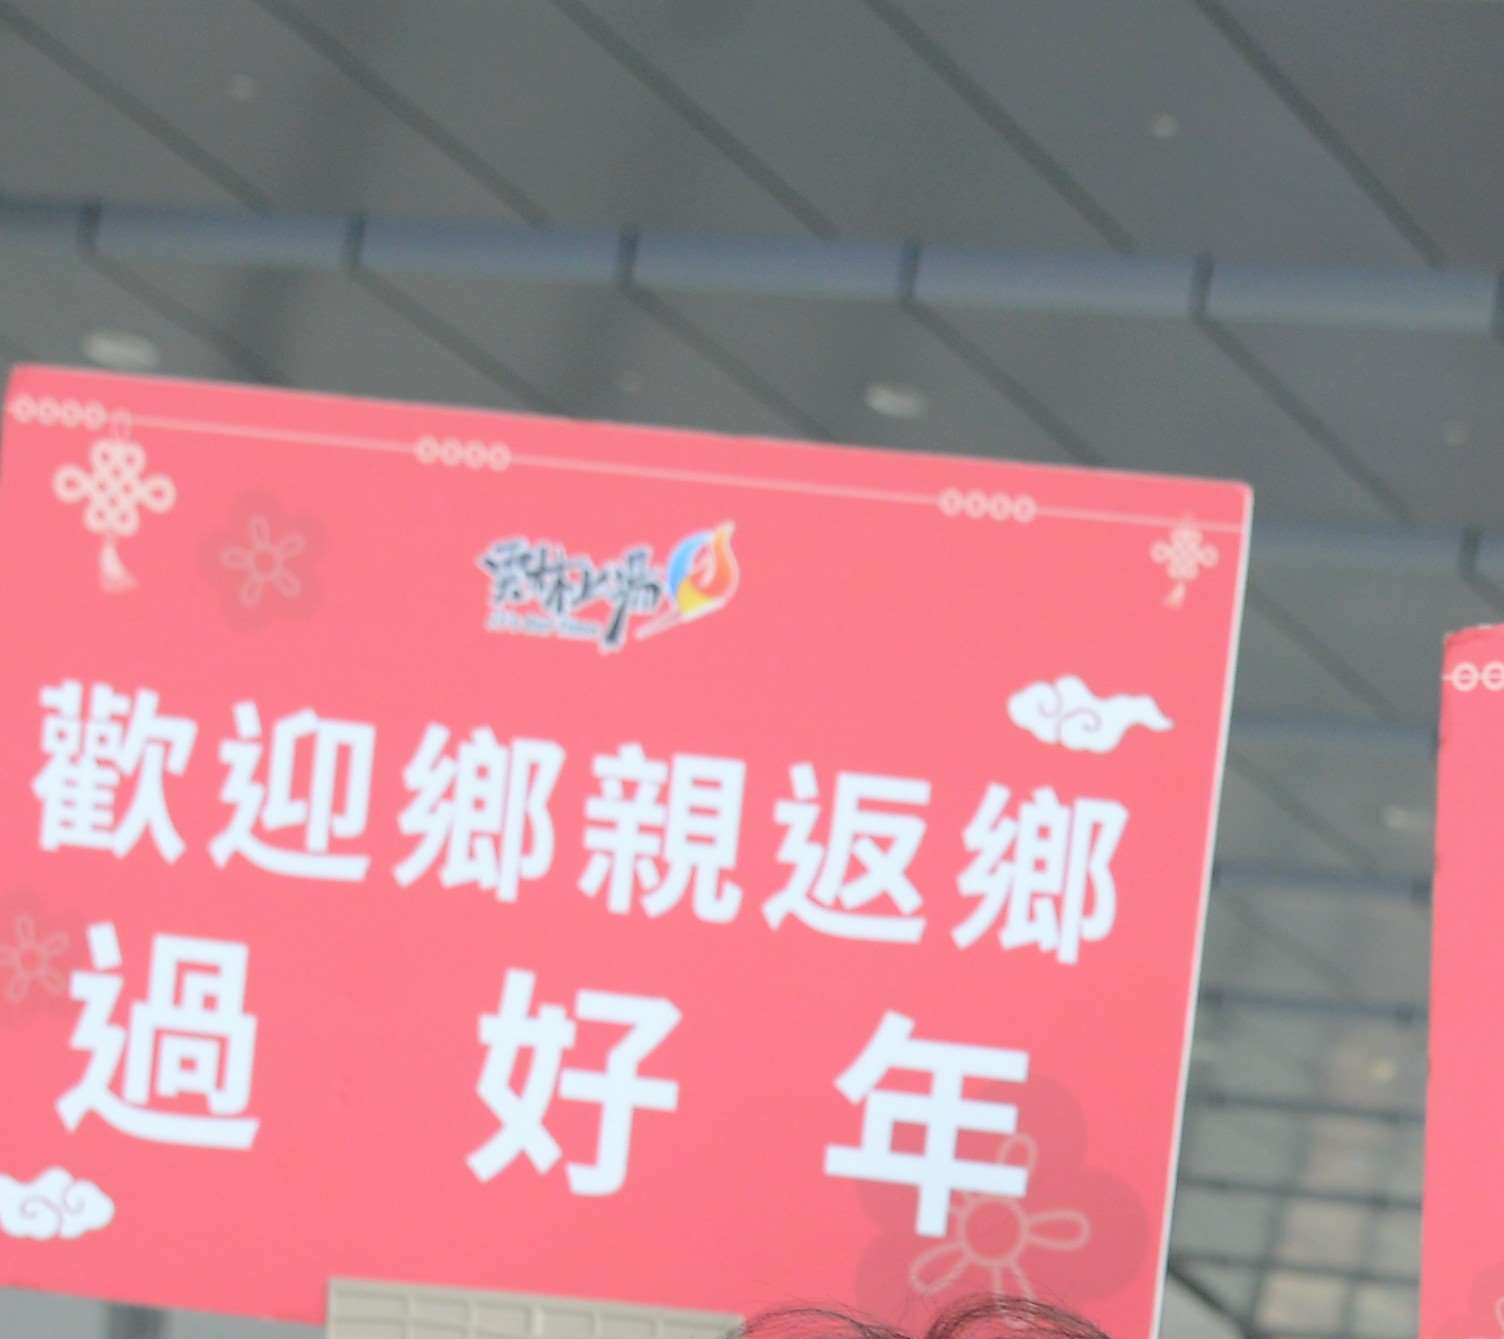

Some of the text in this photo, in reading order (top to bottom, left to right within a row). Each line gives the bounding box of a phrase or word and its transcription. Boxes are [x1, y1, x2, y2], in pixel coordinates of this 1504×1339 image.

[32, 678, 1128, 964] 歡迎鄉親返鄉
